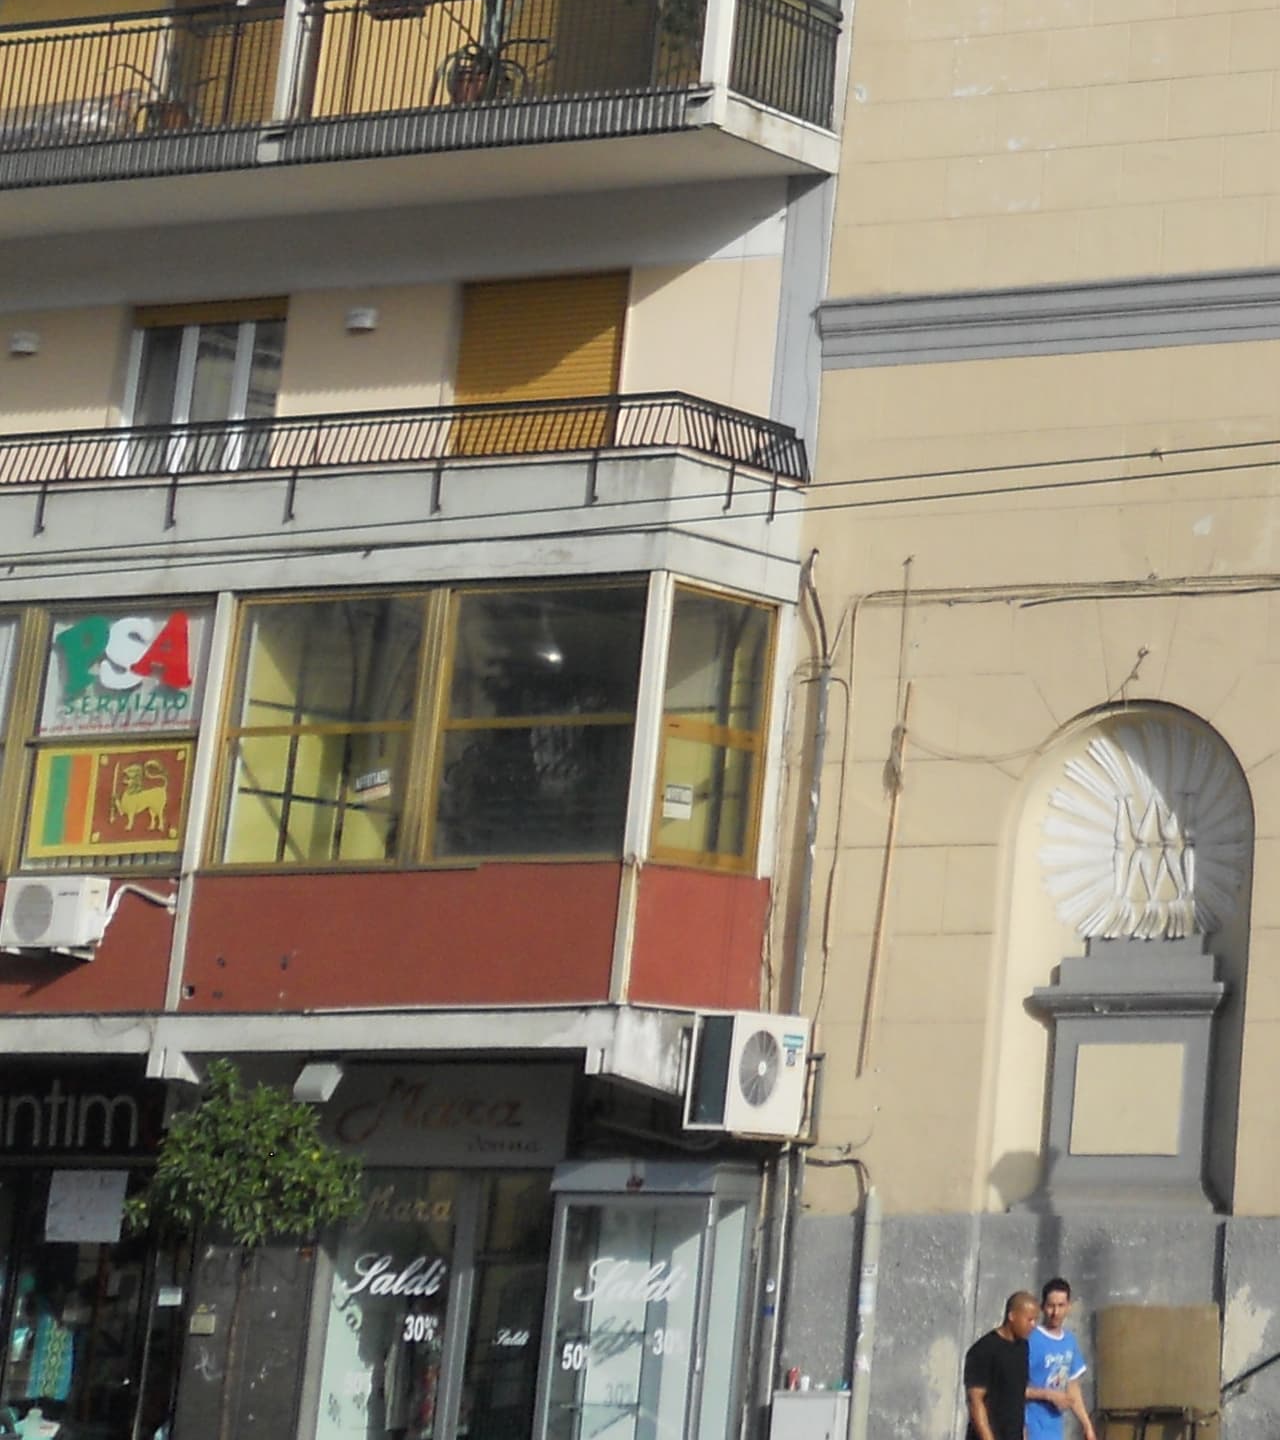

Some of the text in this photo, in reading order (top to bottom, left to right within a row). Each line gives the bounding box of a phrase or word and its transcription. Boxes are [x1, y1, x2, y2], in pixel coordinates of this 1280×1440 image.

[56, 610, 193, 699] PSA
[63, 691, 188, 717] SERVIZIO
[344, 1252, 447, 1297] Saldi
